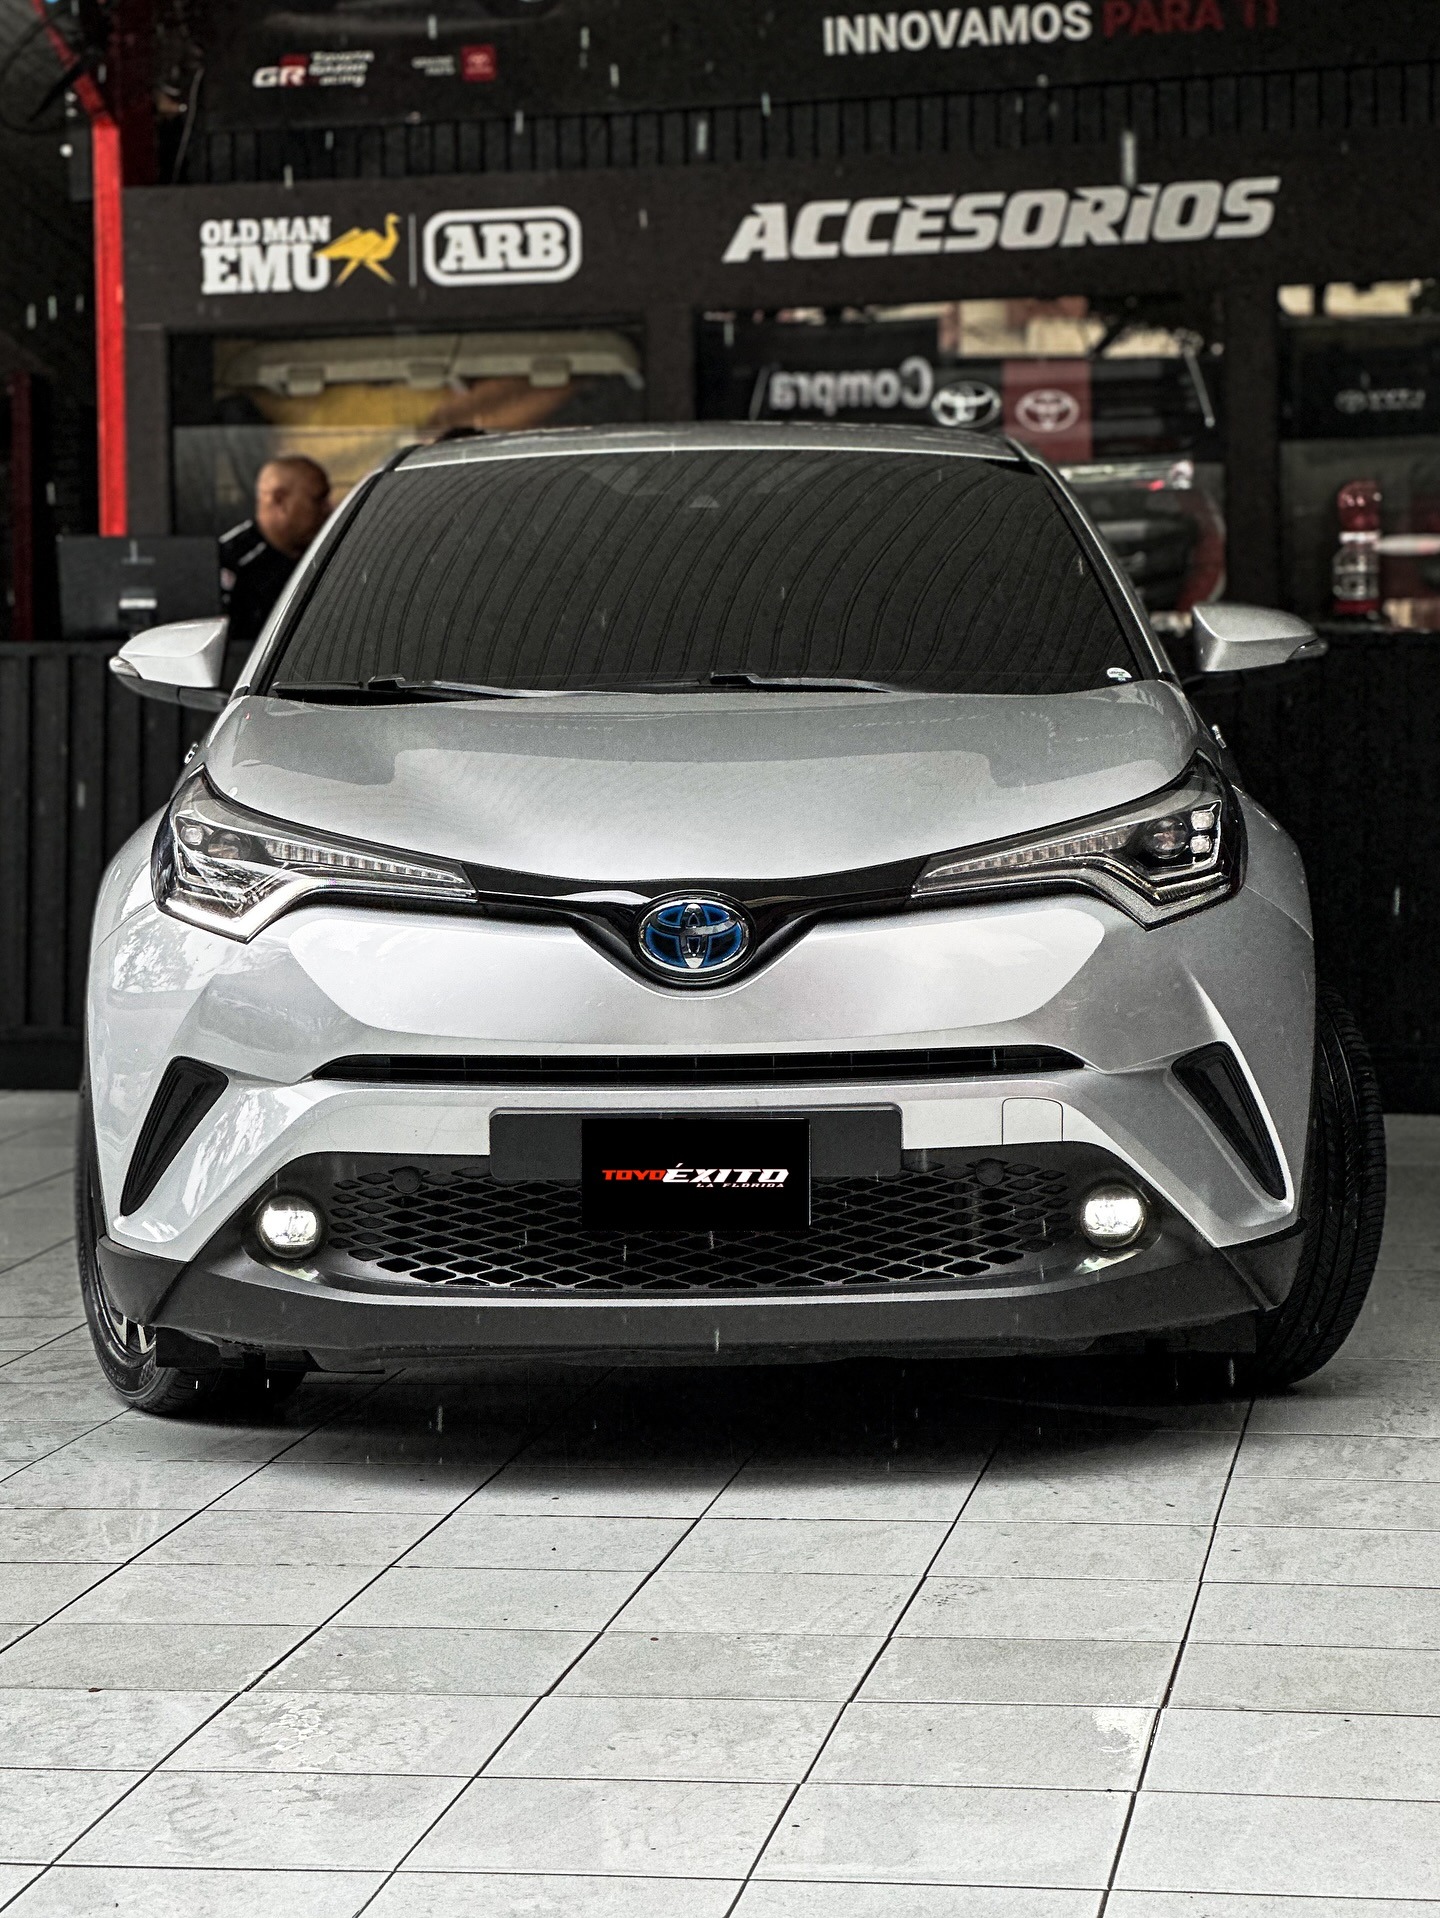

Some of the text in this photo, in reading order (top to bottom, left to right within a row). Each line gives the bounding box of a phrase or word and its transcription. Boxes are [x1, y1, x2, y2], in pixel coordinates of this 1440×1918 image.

[823, 1, 1092, 56] INNOVAMOS
[1102, 0, 1225, 38] PARA
[252, 65, 306, 88] GR
[200, 215, 331, 244] OLD MAN
[721, 177, 1281, 263] ACCESORIOS
[201, 243, 331, 294] EMU
[440, 221, 568, 273] ARB
